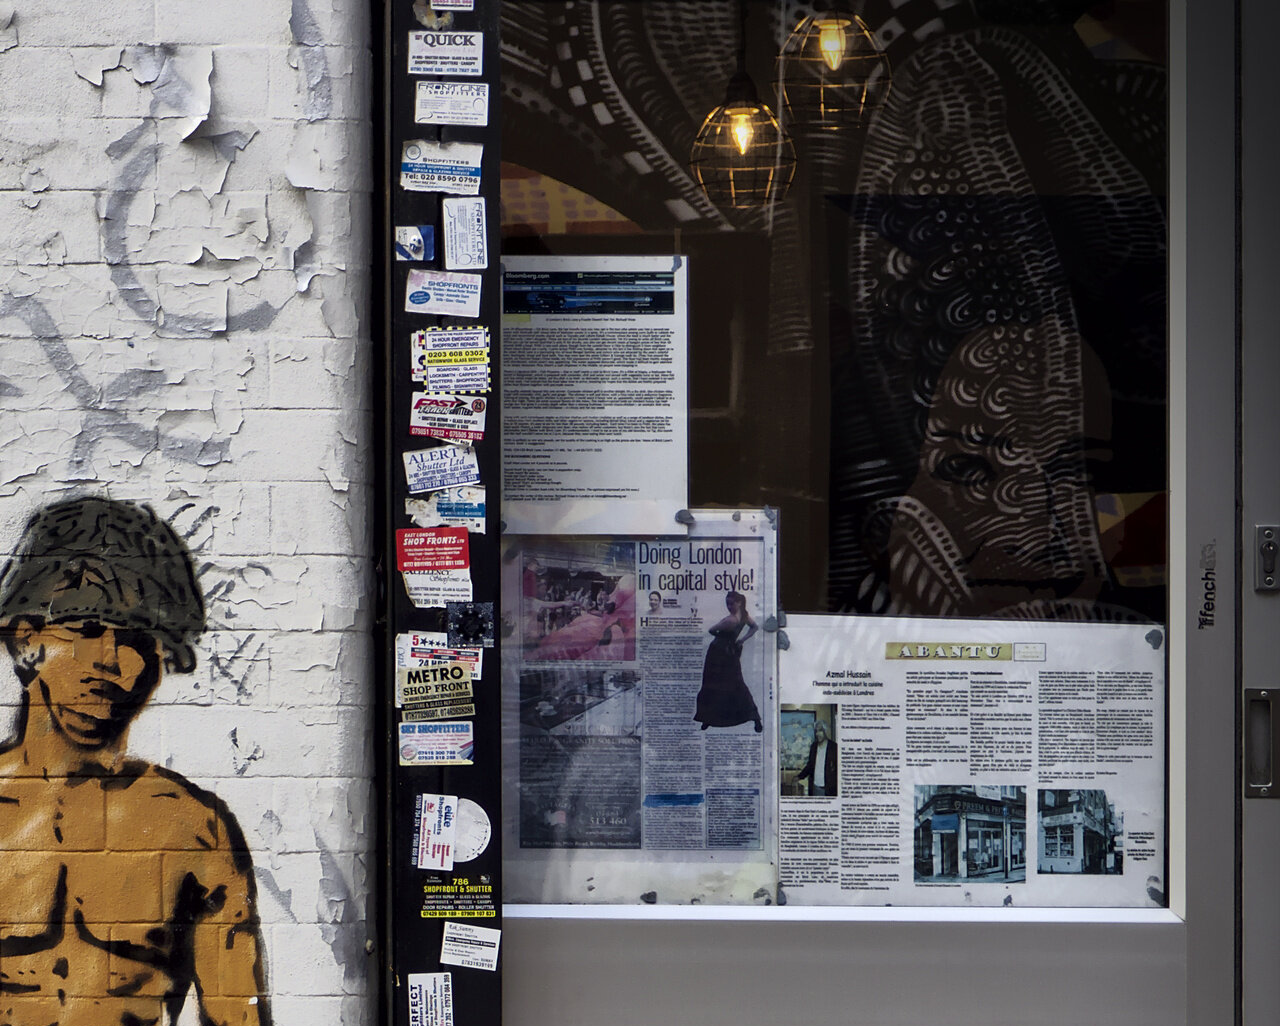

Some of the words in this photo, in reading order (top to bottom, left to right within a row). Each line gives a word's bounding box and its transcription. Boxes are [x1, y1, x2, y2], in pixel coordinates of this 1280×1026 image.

[423, 34, 476, 47] QUICK
[428, 281, 478, 290] SHOPFRONTS
[414, 398, 462, 409] FAST
[408, 447, 459, 465] ALERT
[416, 461, 447, 472] Shutter
[449, 456, 465, 467] Ltd
[403, 537, 425, 546] SHOP
[426, 536, 457, 545] FRONTS
[639, 542, 682, 569] Doing
[689, 543, 742, 565] London
[639, 570, 651, 591] in
[658, 568, 706, 595] capital
[714, 569, 754, 593] style!
[412, 635, 419, 646] 5
[898, 645, 1002, 658] ABANTU
[407, 666, 464, 684] METRO
[403, 685, 431, 696] SHOP
[435, 682, 469, 692] FRONT
[401, 725, 416, 733] SKY
[418, 724, 470, 733] SHOPFITTERS
[437, 797, 445, 835] Shopfronts
[444, 805, 455, 828] elite
